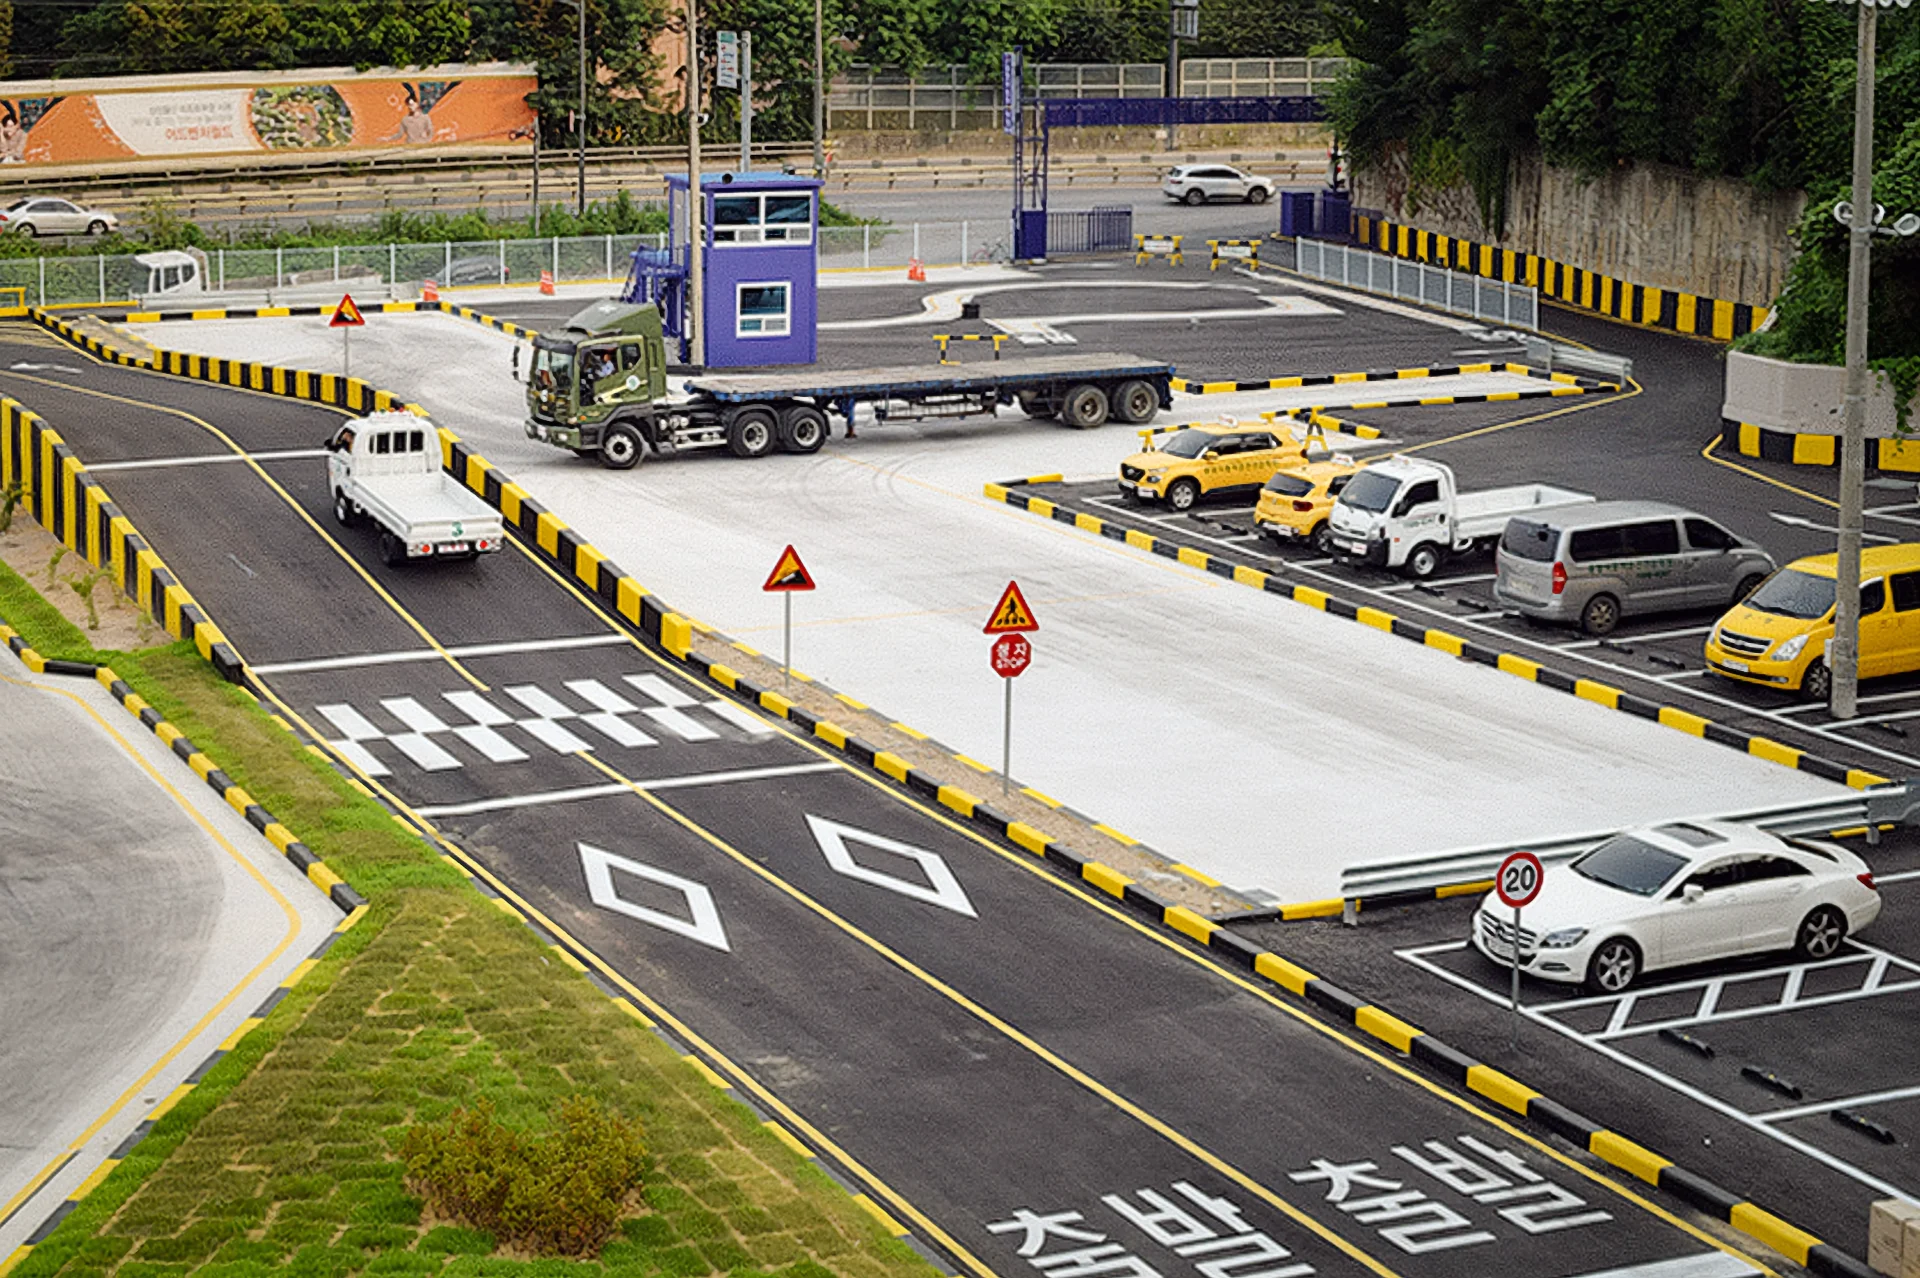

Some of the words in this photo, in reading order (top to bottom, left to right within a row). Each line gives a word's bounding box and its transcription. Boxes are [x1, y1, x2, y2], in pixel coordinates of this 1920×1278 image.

[451, 521, 463, 537] 3
[1505, 864, 1536, 892] 20
[1288, 1134, 1613, 1254] 출발
